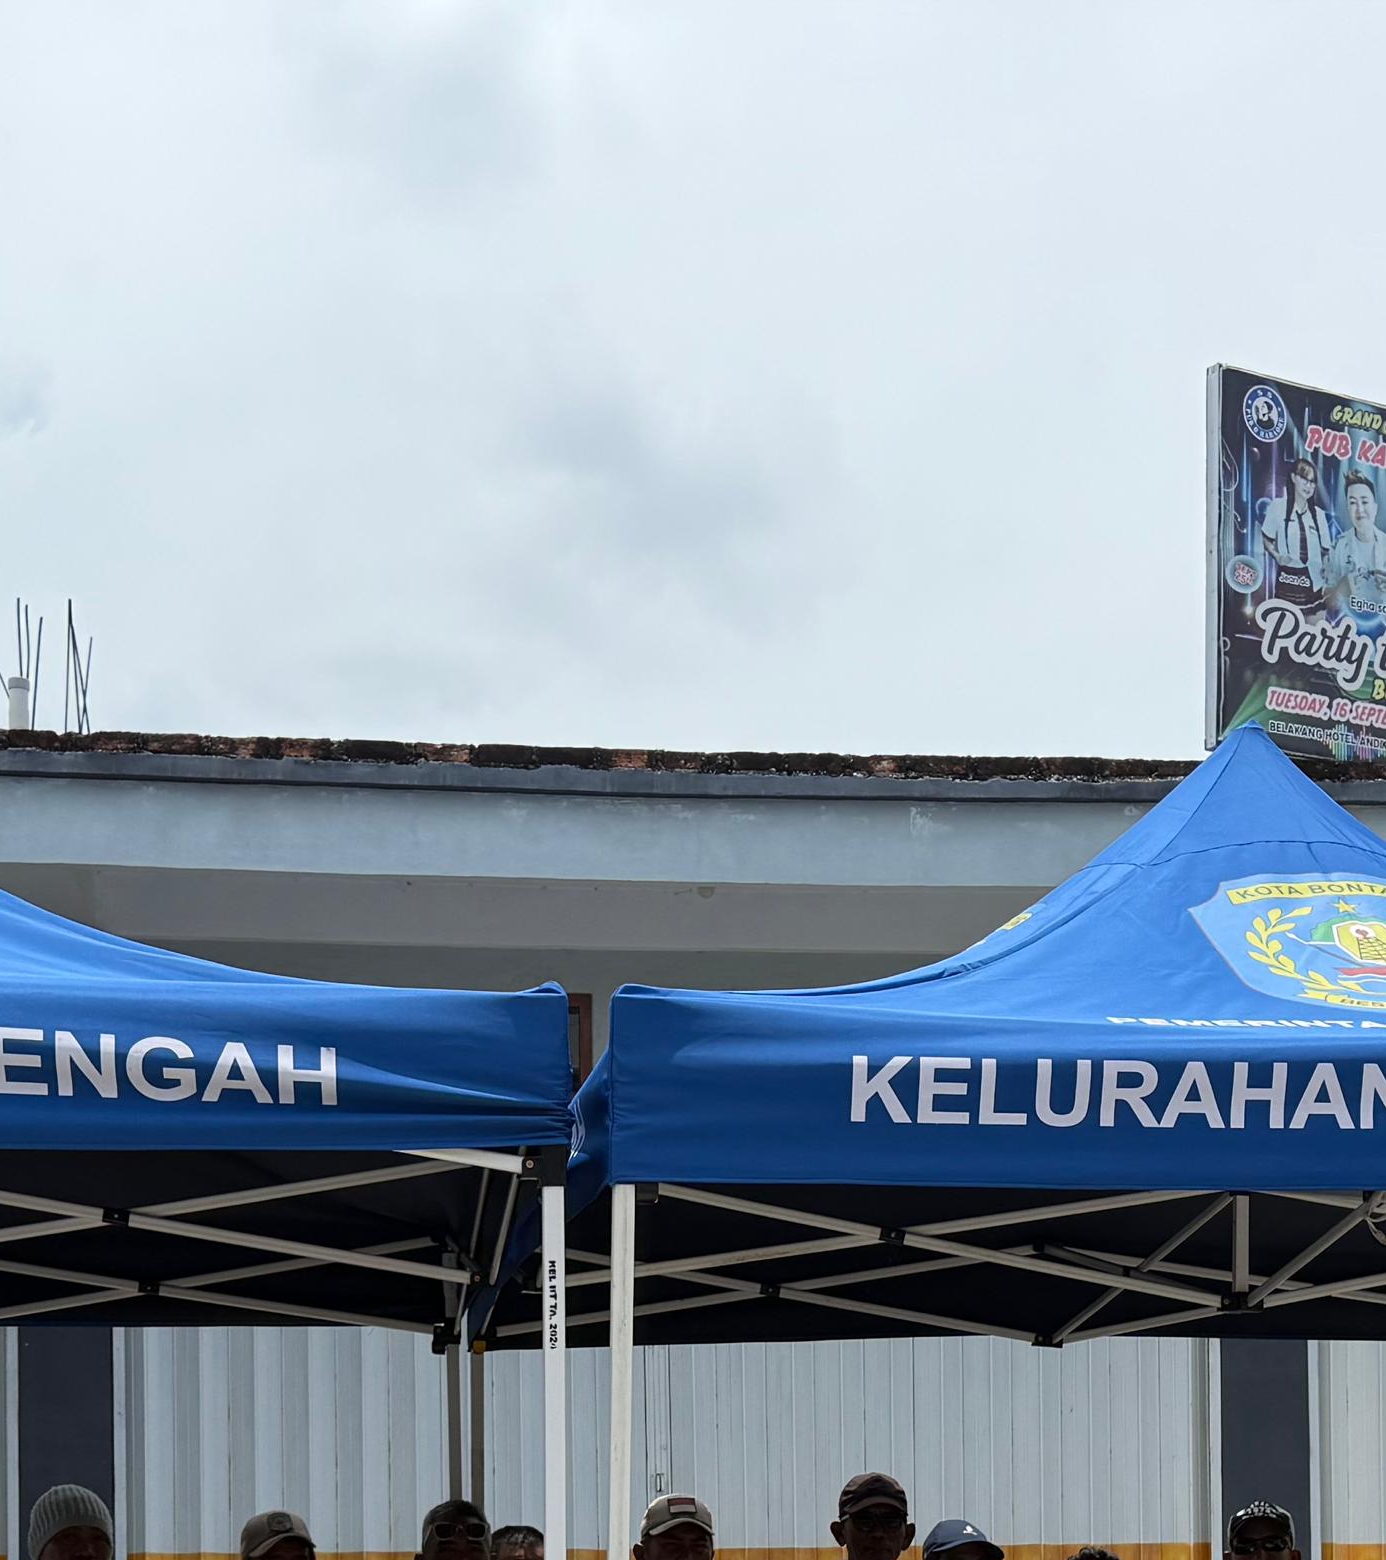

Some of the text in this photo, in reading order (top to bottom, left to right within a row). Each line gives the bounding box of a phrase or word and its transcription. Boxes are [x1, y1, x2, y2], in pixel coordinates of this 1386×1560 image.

[1331, 405, 1383, 431] GRAND
[1306, 425, 1352, 460] PUB
[1259, 605, 1367, 685] Party
[1333, 700, 1349, 719] 16
[1269, 721, 1323, 740] BELAKANG
[1324, 730, 1357, 745] HOTEL
[1235, 884, 1305, 900] KOTA
